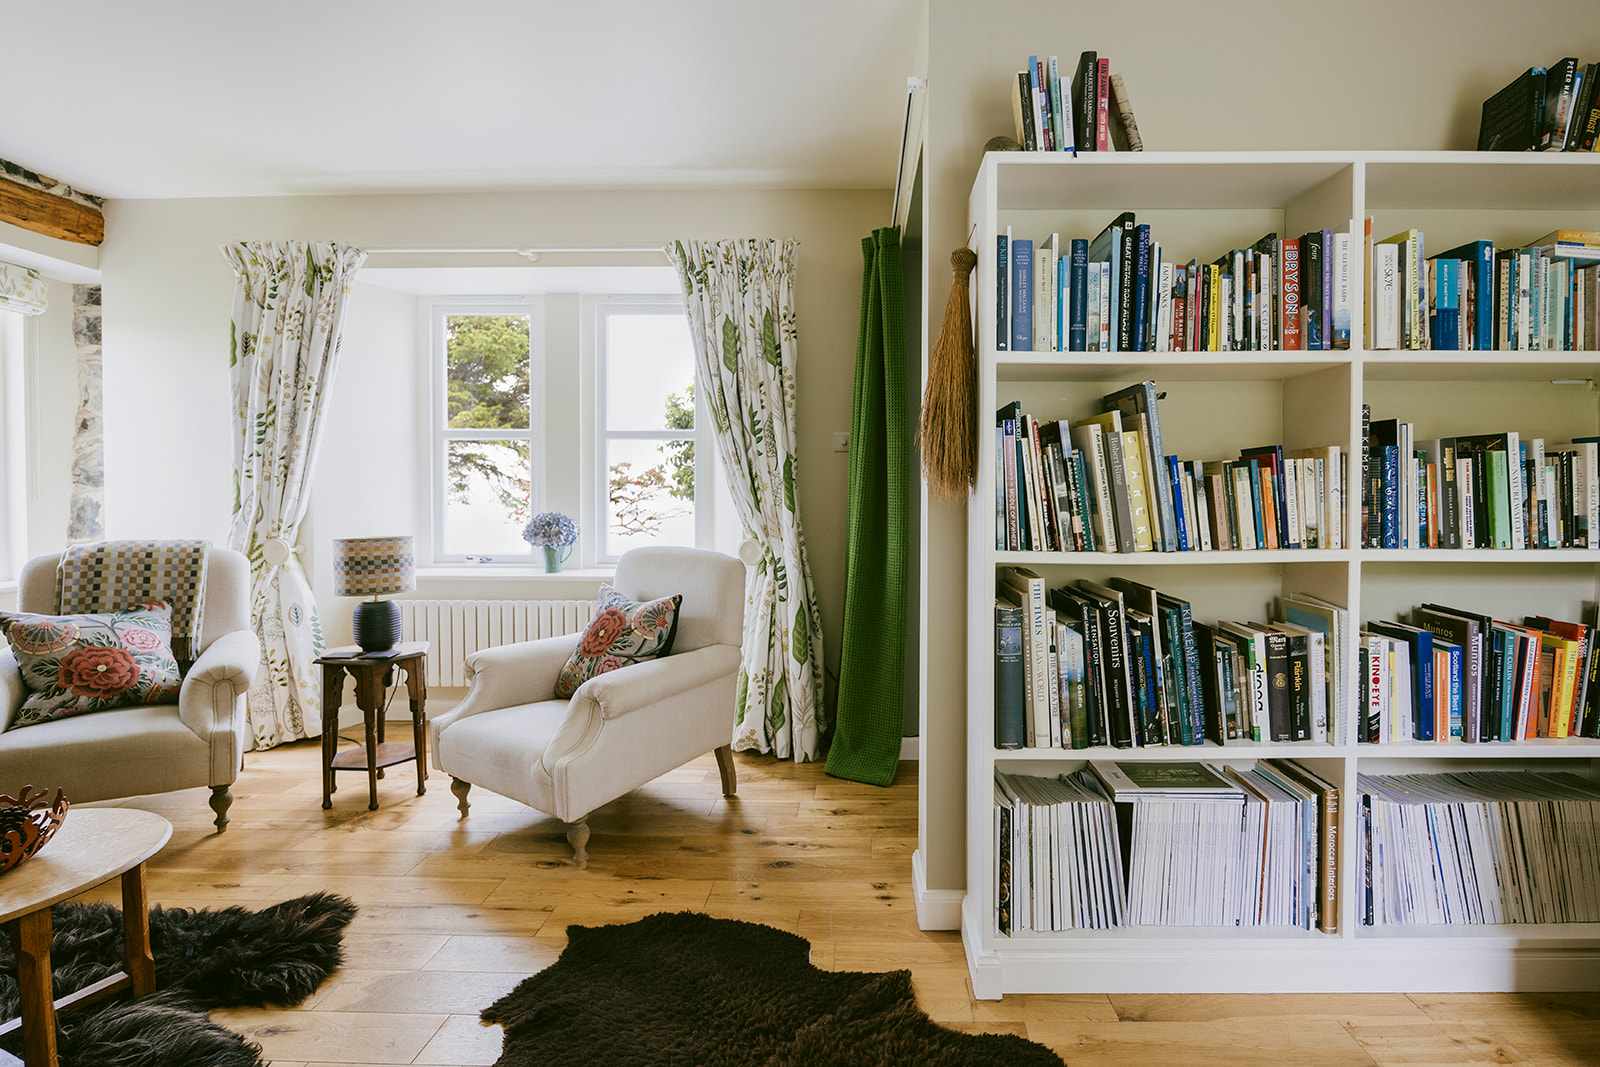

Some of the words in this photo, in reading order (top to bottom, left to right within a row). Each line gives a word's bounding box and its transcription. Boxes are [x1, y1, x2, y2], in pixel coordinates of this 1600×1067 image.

[1565, 61, 1574, 83] PETER
[1562, 85, 1570, 99] MAY
[1586, 108, 1600, 133] Ghost
[1285, 251, 1298, 314] BRYSON
[1122, 310, 1130, 331] ATLAS
[1149, 389, 1160, 437] Impressionism
[1111, 437, 1121, 463] Robert
[1114, 465, 1123, 485] Kime
[1011, 509, 1016, 519] OF
[1512, 469, 1521, 533] NATUREWATCH
[1033, 582, 1041, 602] THE
[1034, 605, 1042, 636] TIMES
[1182, 608, 1192, 627] KIT
[1423, 623, 1454, 638] Munros
[1035, 640, 1044, 665] ATLAS
[1091, 625, 1099, 665] SENSATION
[1107, 609, 1122, 668] Souvenirs
[1184, 631, 1195, 664] KEMP
[1142, 636, 1153, 676] magnum
[1036, 671, 1045, 702] WORLD
[1294, 661, 1302, 691] Rankin
[1567, 665, 1575, 680] BBC
[1146, 678, 1156, 713] cinema
[1328, 826, 1337, 866] Moroccan
[1328, 867, 1336, 901] Interiors
